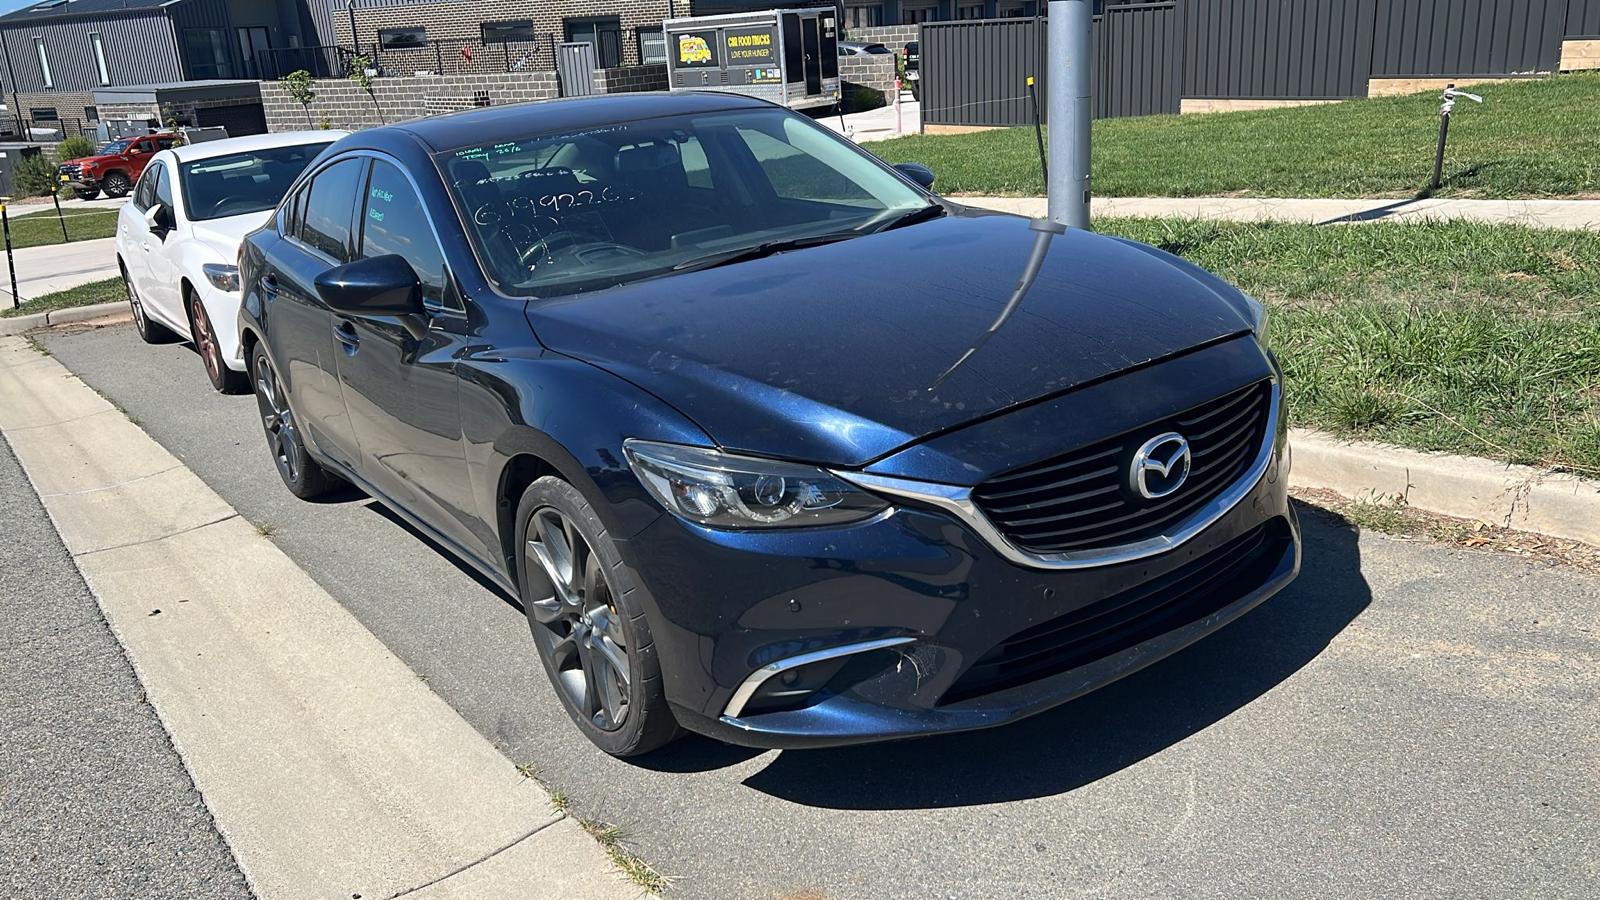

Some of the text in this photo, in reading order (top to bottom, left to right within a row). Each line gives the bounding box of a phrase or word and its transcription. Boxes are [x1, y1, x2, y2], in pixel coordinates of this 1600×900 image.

[738, 36, 752, 46] FOOD
[752, 34, 770, 46] TRUCKS
[730, 50, 742, 58] LOVE
[752, 48, 770, 58] HUNGER
